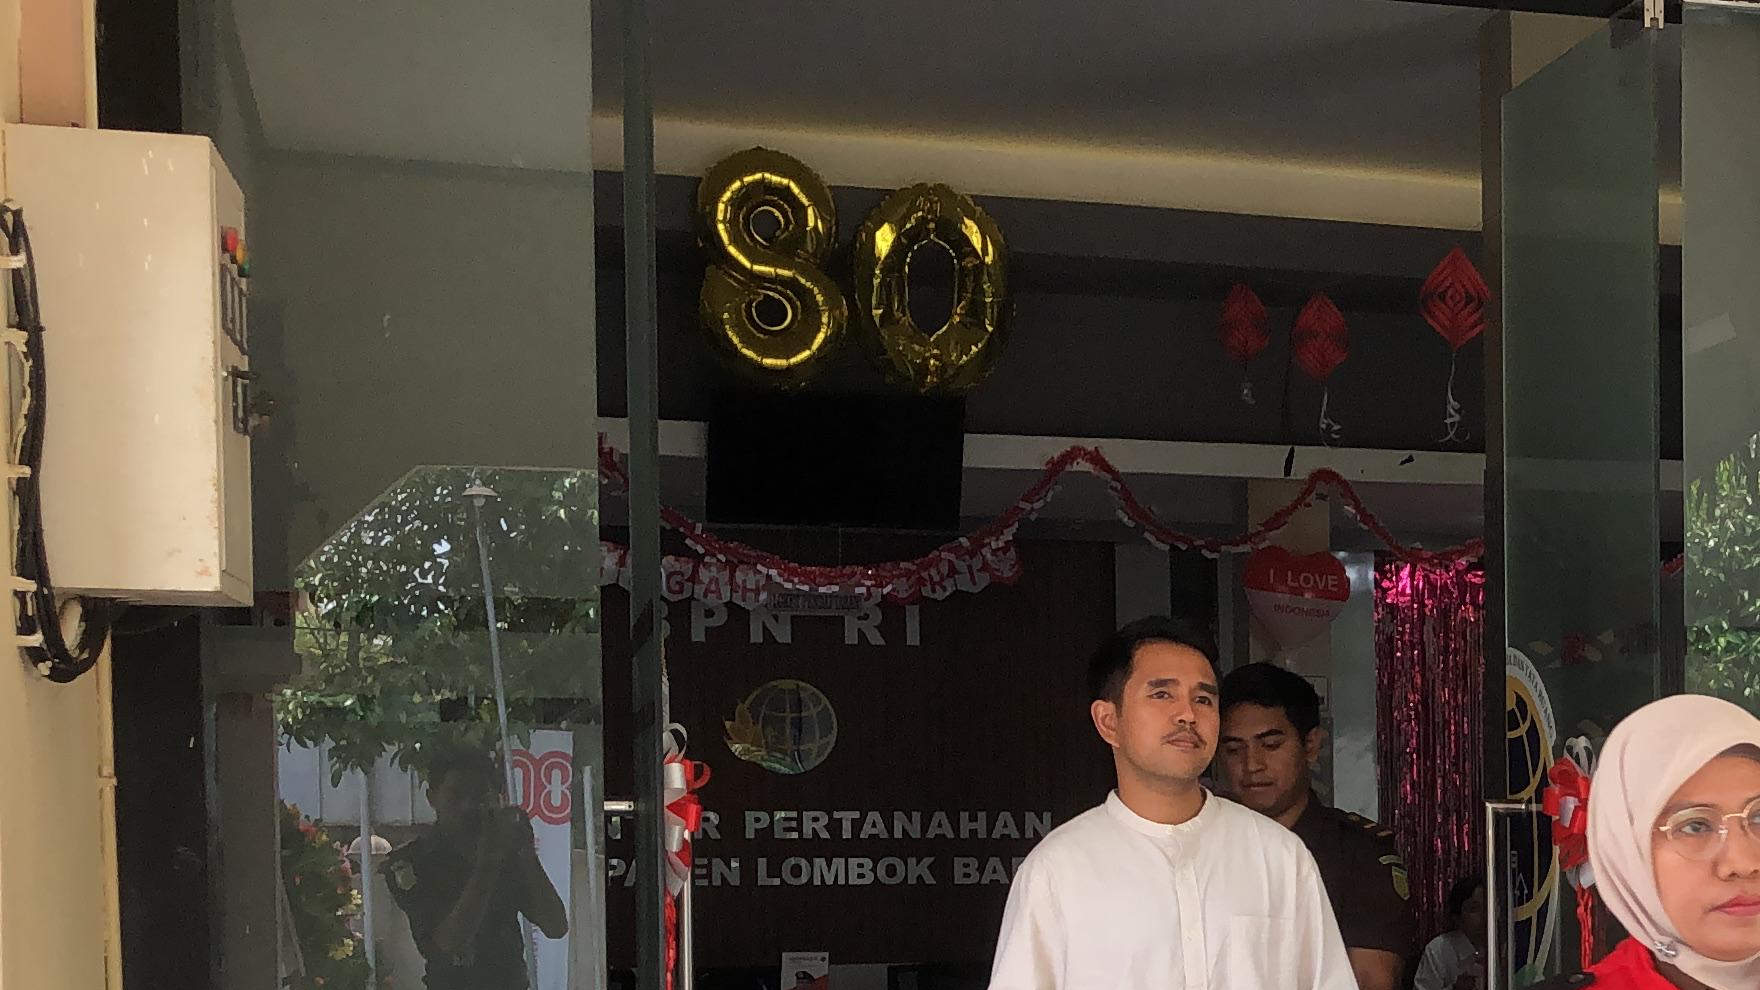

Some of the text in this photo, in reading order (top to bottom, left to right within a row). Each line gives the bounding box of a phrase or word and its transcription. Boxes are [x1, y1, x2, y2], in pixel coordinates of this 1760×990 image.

[697, 145, 1012, 394] 80
[1269, 567, 1339, 592] I LOVE
[845, 603, 920, 647] RI
[745, 810, 1053, 840] PERTANAHAN
[757, 856, 937, 886] LOMBOK
